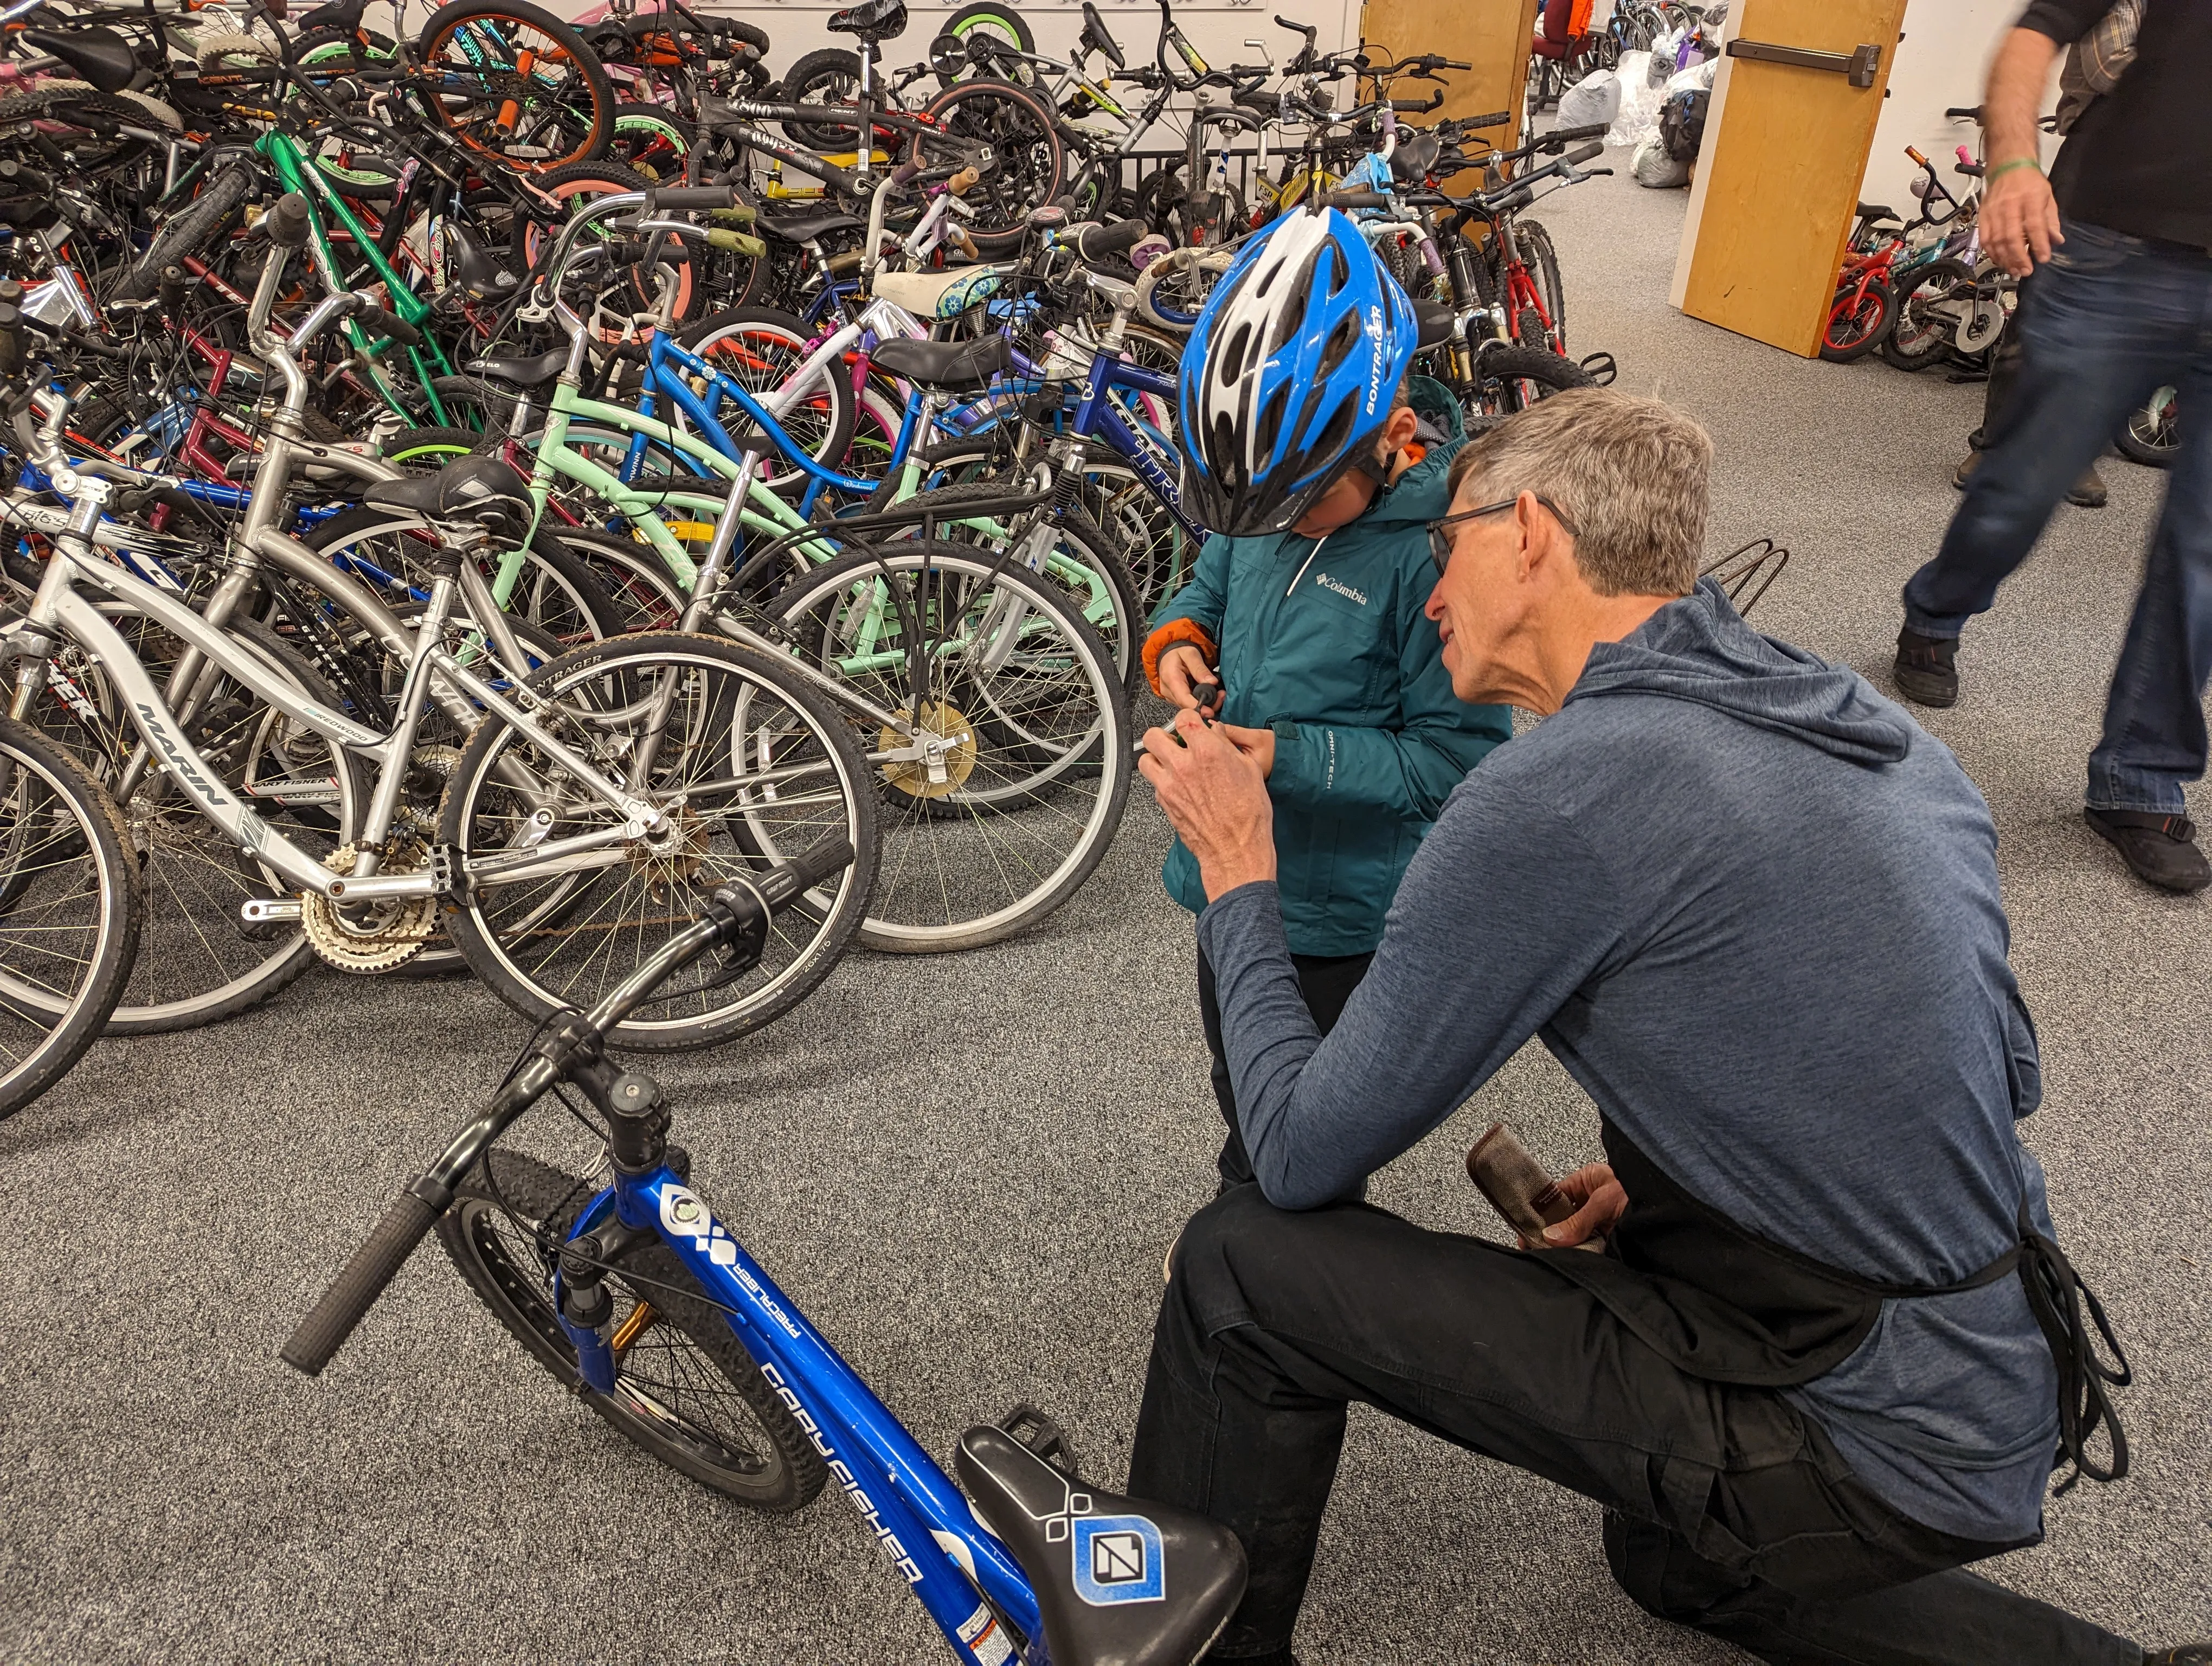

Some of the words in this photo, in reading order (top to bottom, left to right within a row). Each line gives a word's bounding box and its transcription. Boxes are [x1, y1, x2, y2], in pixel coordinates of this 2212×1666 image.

[197, 75, 243, 85] KENT
[921, 126, 942, 135] KENT
[1257, 184, 1274, 202] FSR
[1282, 172, 1306, 206] SPECIALIZED
[1365, 304, 1382, 415] BONTRAGER
[449, 473, 477, 495] MARIN
[843, 479, 873, 491] Windwood
[1130, 440, 1213, 544] TR
[1324, 576, 1368, 606] Columbia
[300, 624, 349, 685] GENESIS
[532, 654, 603, 694] ONTRAGER
[801, 671, 875, 710] electra
[316, 713, 368, 741] REDWOOD
[135, 703, 228, 806] MARIN
[1326, 730, 1335, 790] OMNI-TECH
[283, 778, 327, 786] FISHER
[803, 939, 832, 973] 26x1.75
[732, 1263, 802, 1340] PRECALIBER
[760, 1362, 835, 1466] GARY
[833, 1459, 924, 1585] FISHER
